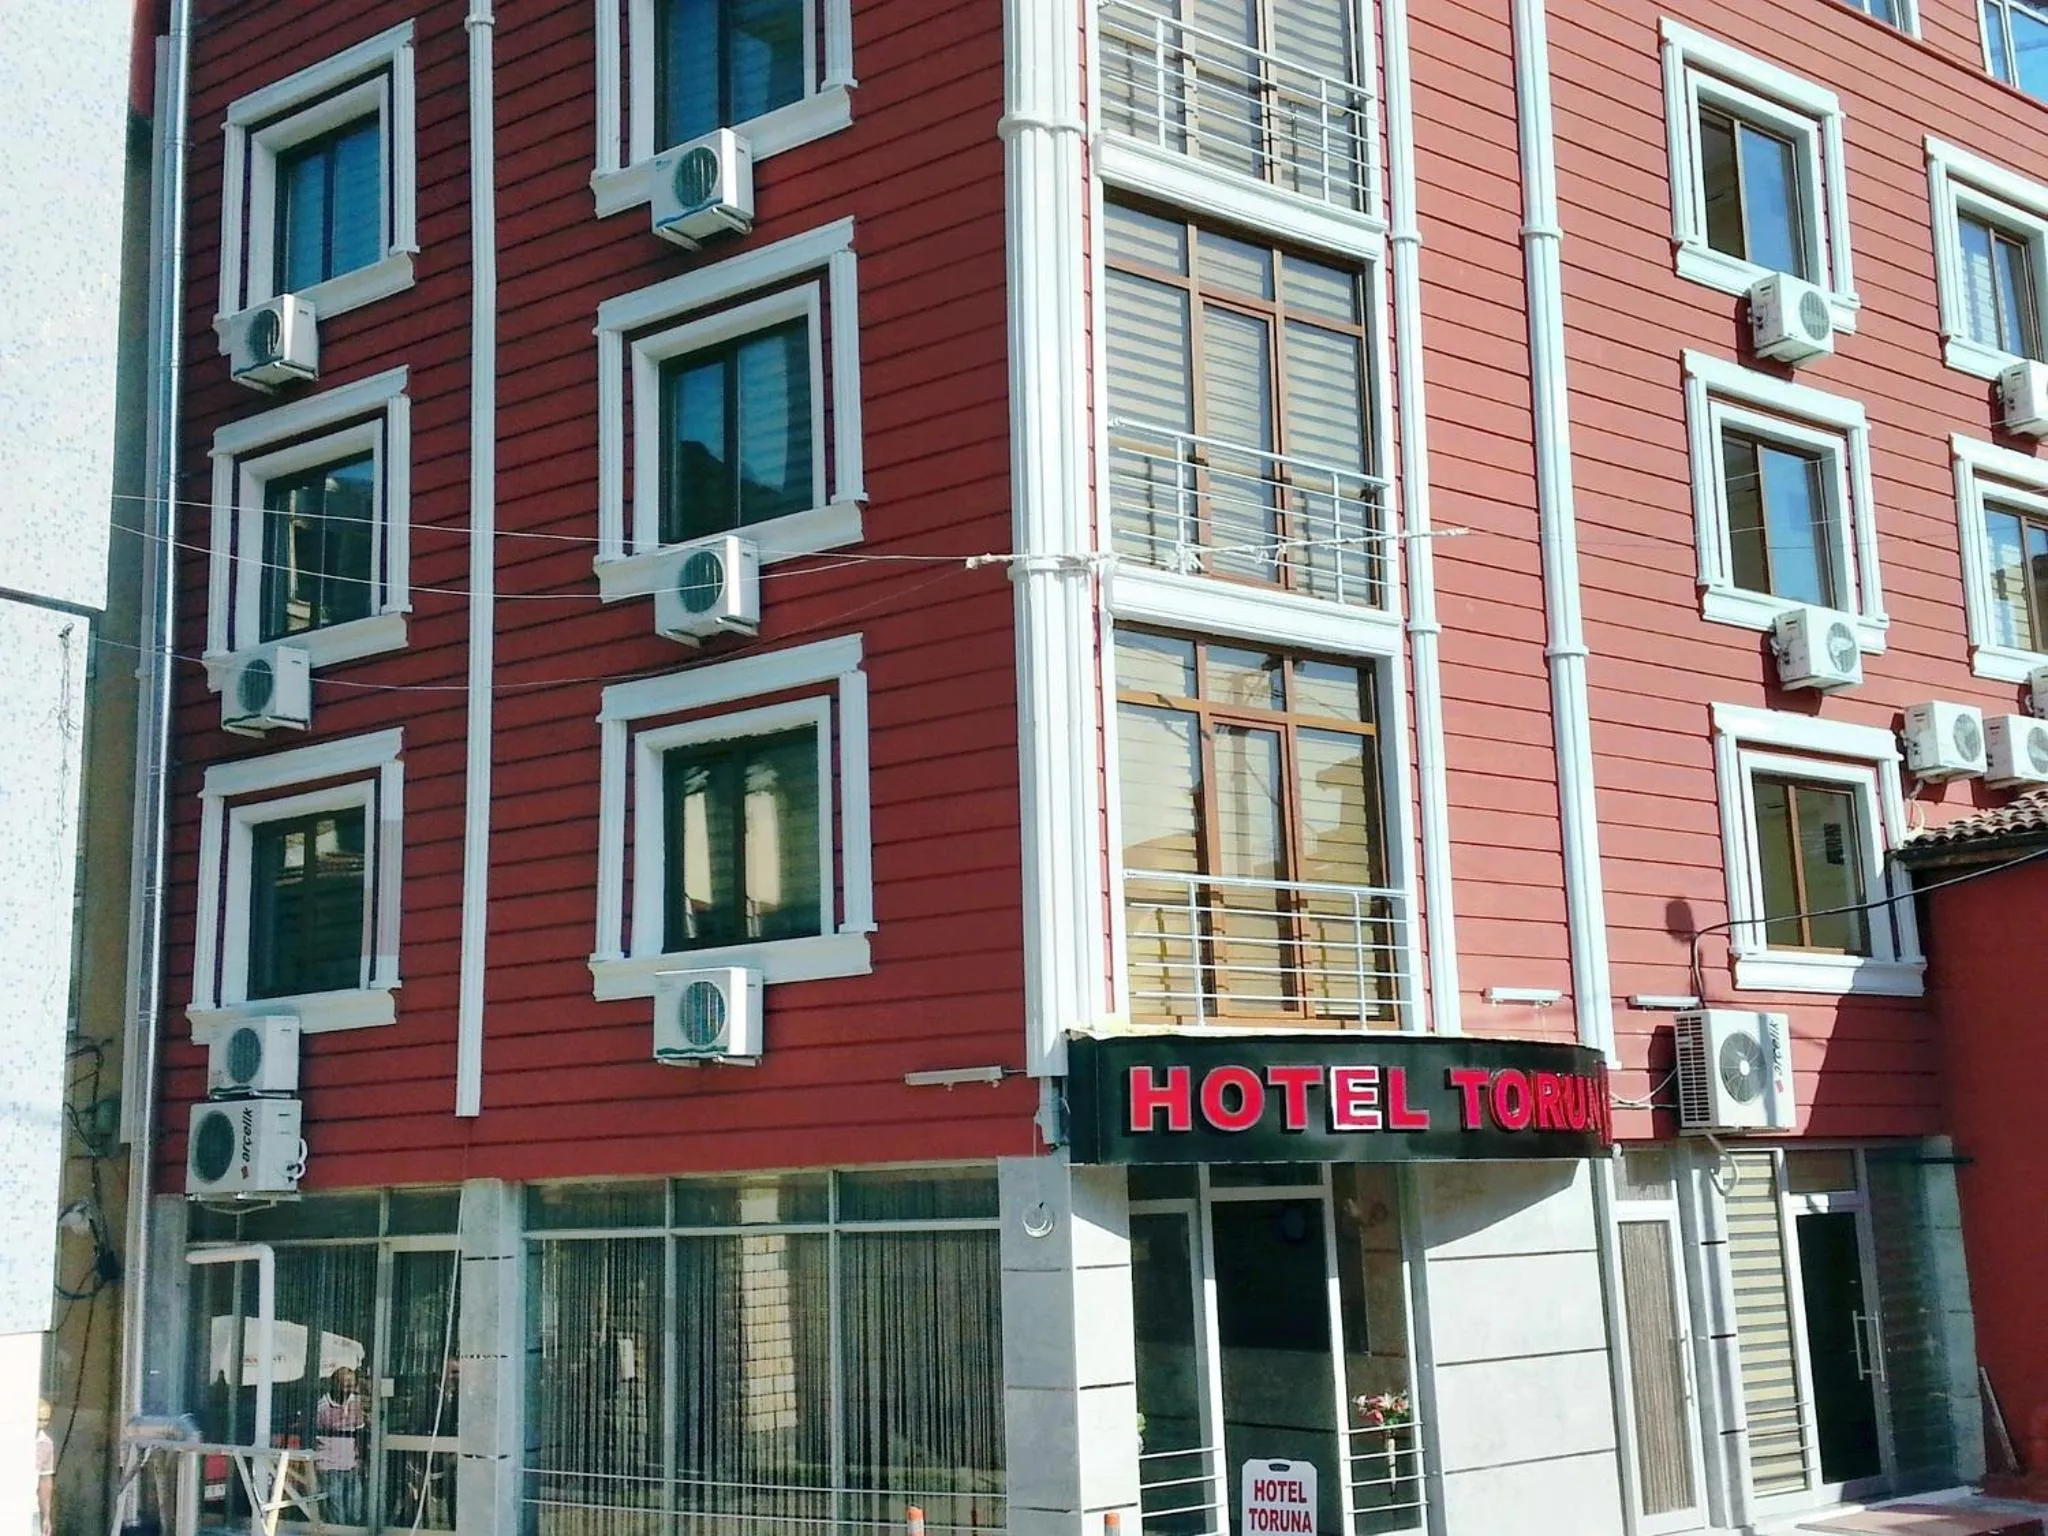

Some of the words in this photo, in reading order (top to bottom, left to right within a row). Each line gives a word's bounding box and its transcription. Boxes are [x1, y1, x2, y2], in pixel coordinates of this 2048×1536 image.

[1128, 1064, 1431, 1132] HOTEL
[1449, 1063, 1612, 1144] TORUN
[1253, 1479, 1308, 1504] HOTEL
[1248, 1508, 1313, 1534] TORUNA
